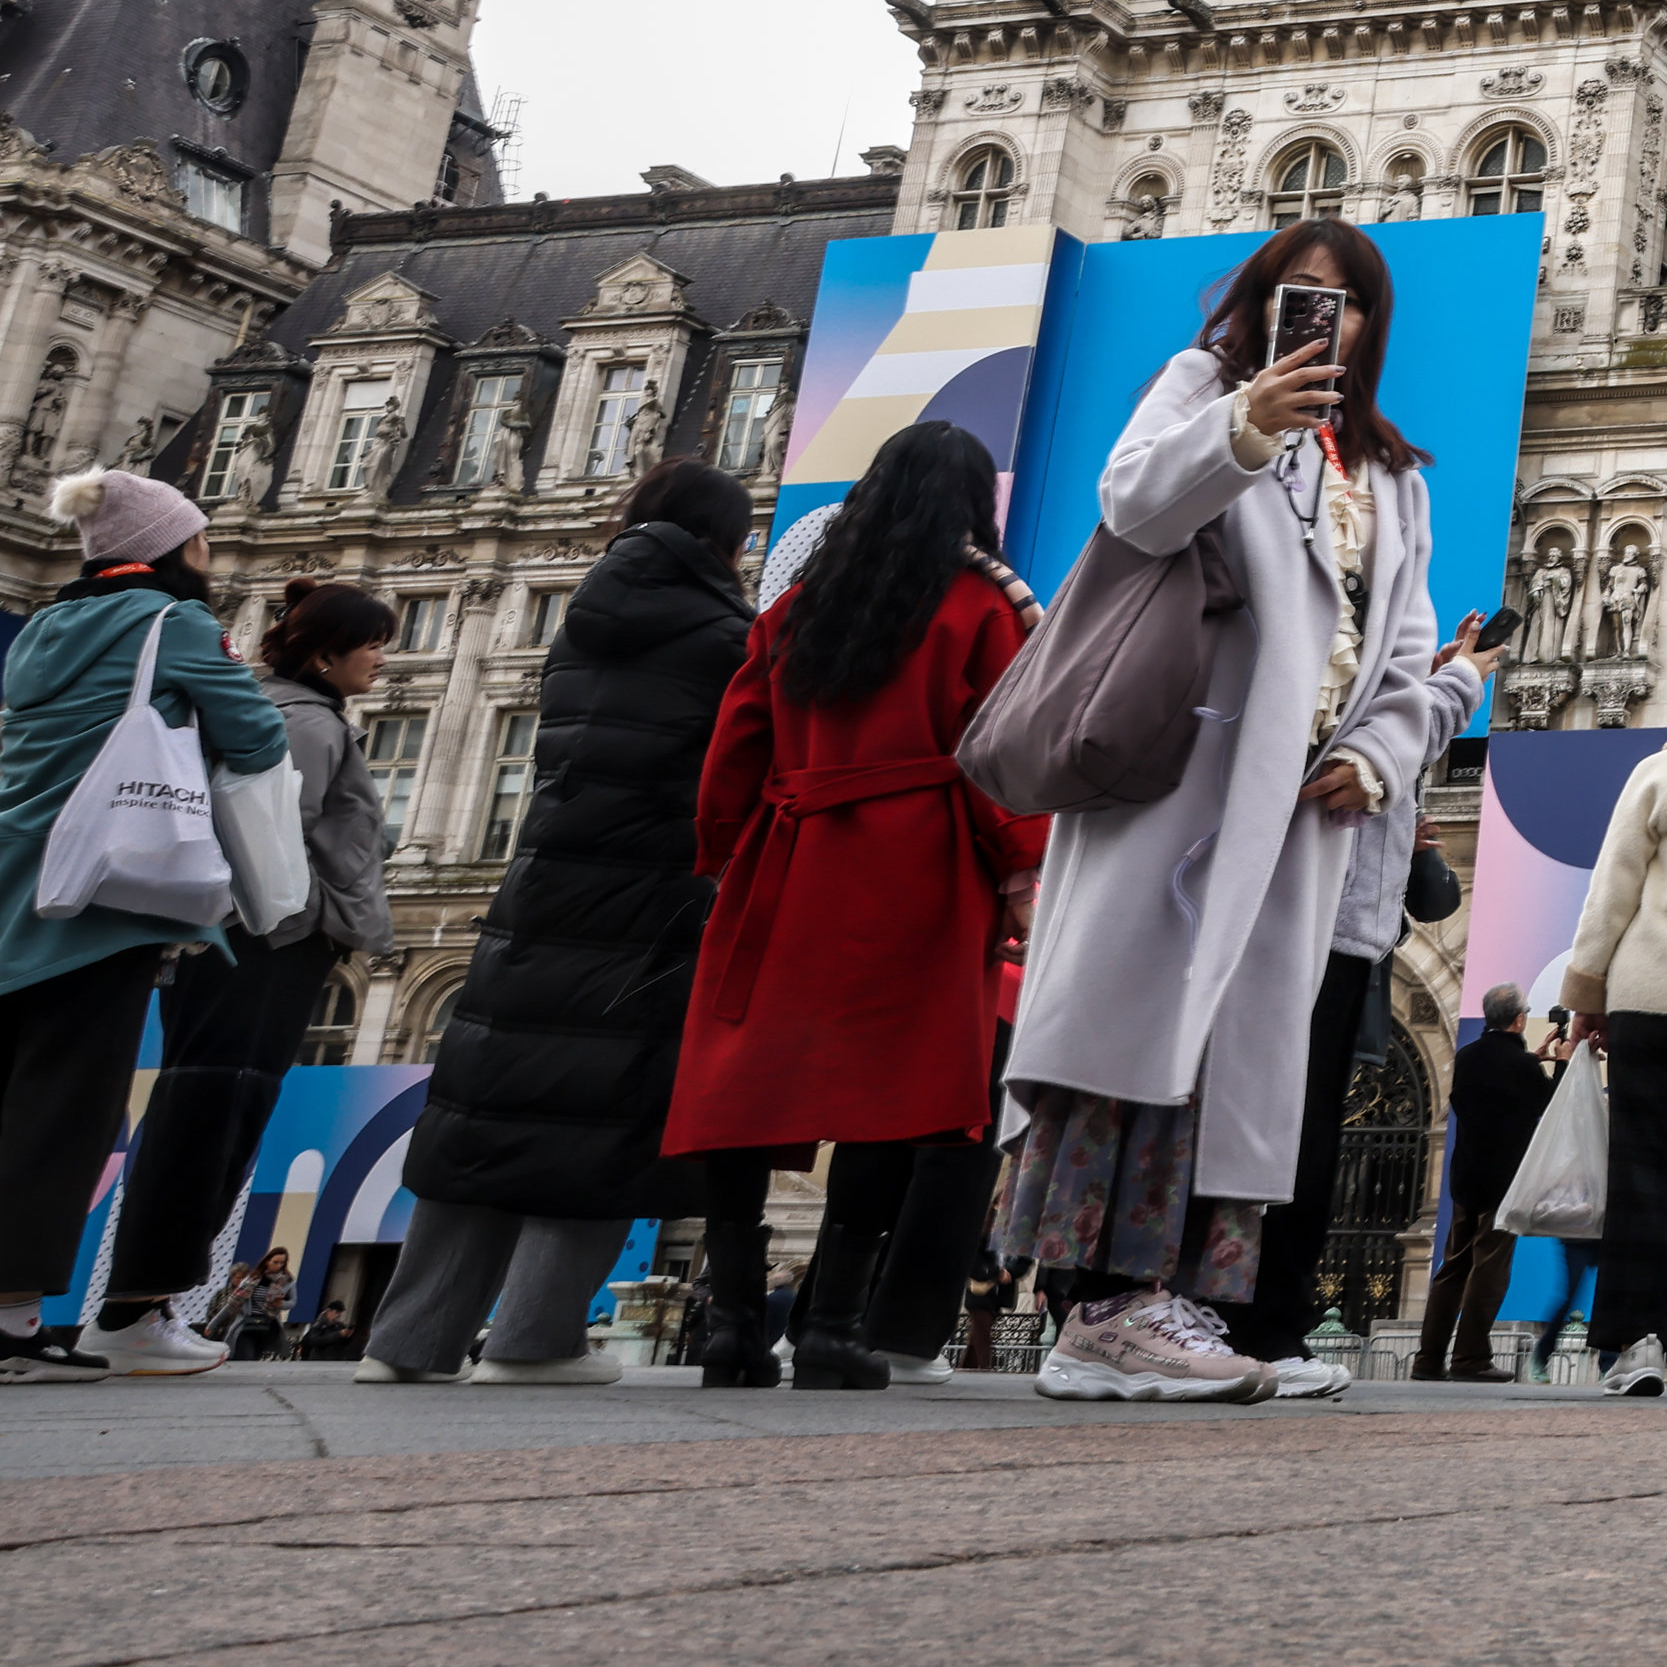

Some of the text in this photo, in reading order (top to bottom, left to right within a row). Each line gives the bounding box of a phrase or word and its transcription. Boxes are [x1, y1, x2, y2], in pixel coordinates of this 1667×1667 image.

[117, 780, 209, 806] HITACH
[110, 797, 210, 818] Inspire the Nex
